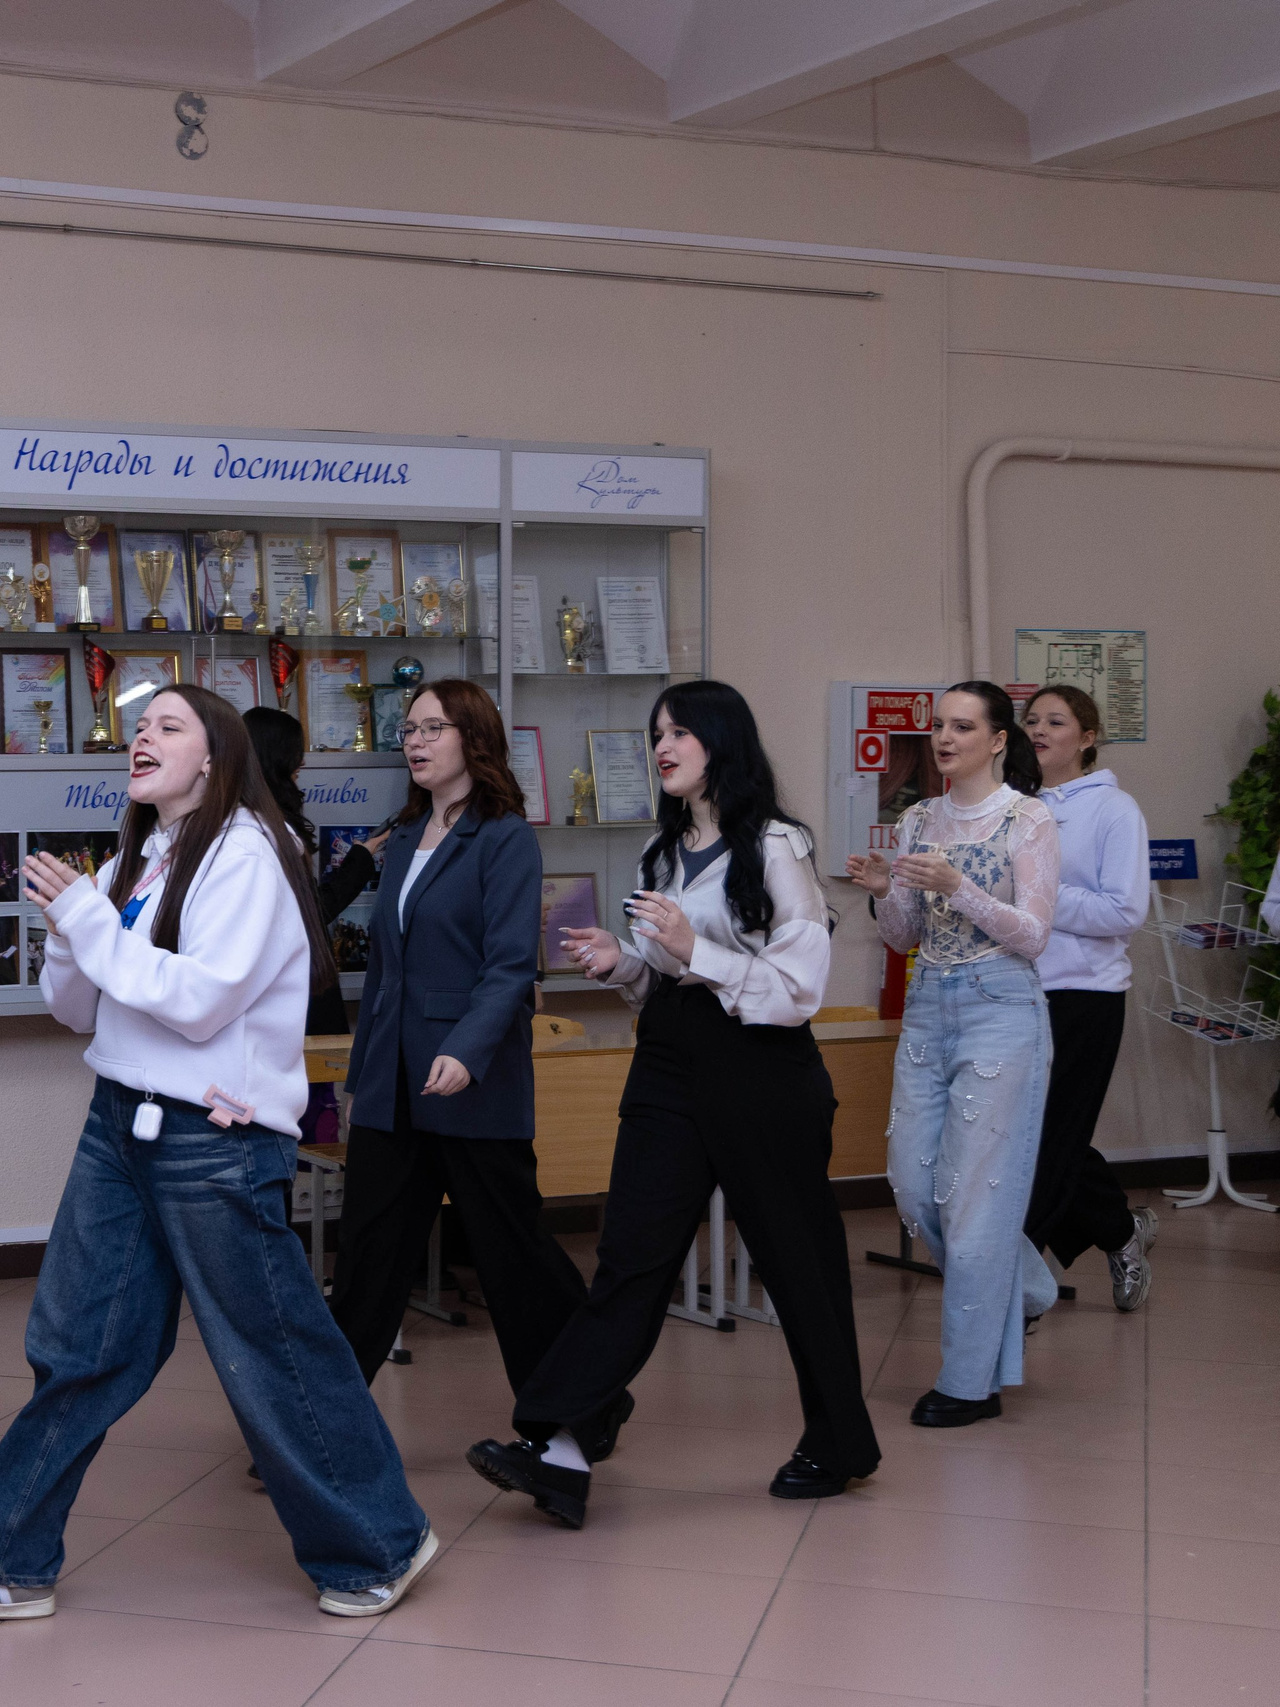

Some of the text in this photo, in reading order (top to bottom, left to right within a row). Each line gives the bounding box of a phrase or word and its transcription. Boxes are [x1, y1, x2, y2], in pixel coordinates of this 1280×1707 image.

[14, 437, 412, 491] Награды и достижения
[592, 457, 638, 483] Дом
[870, 696, 913, 708] ПРИ ПОЖАРЕ
[875, 713, 906, 726] ЗВОНИТЬ
[65, 777, 370, 821] Твор тивы
